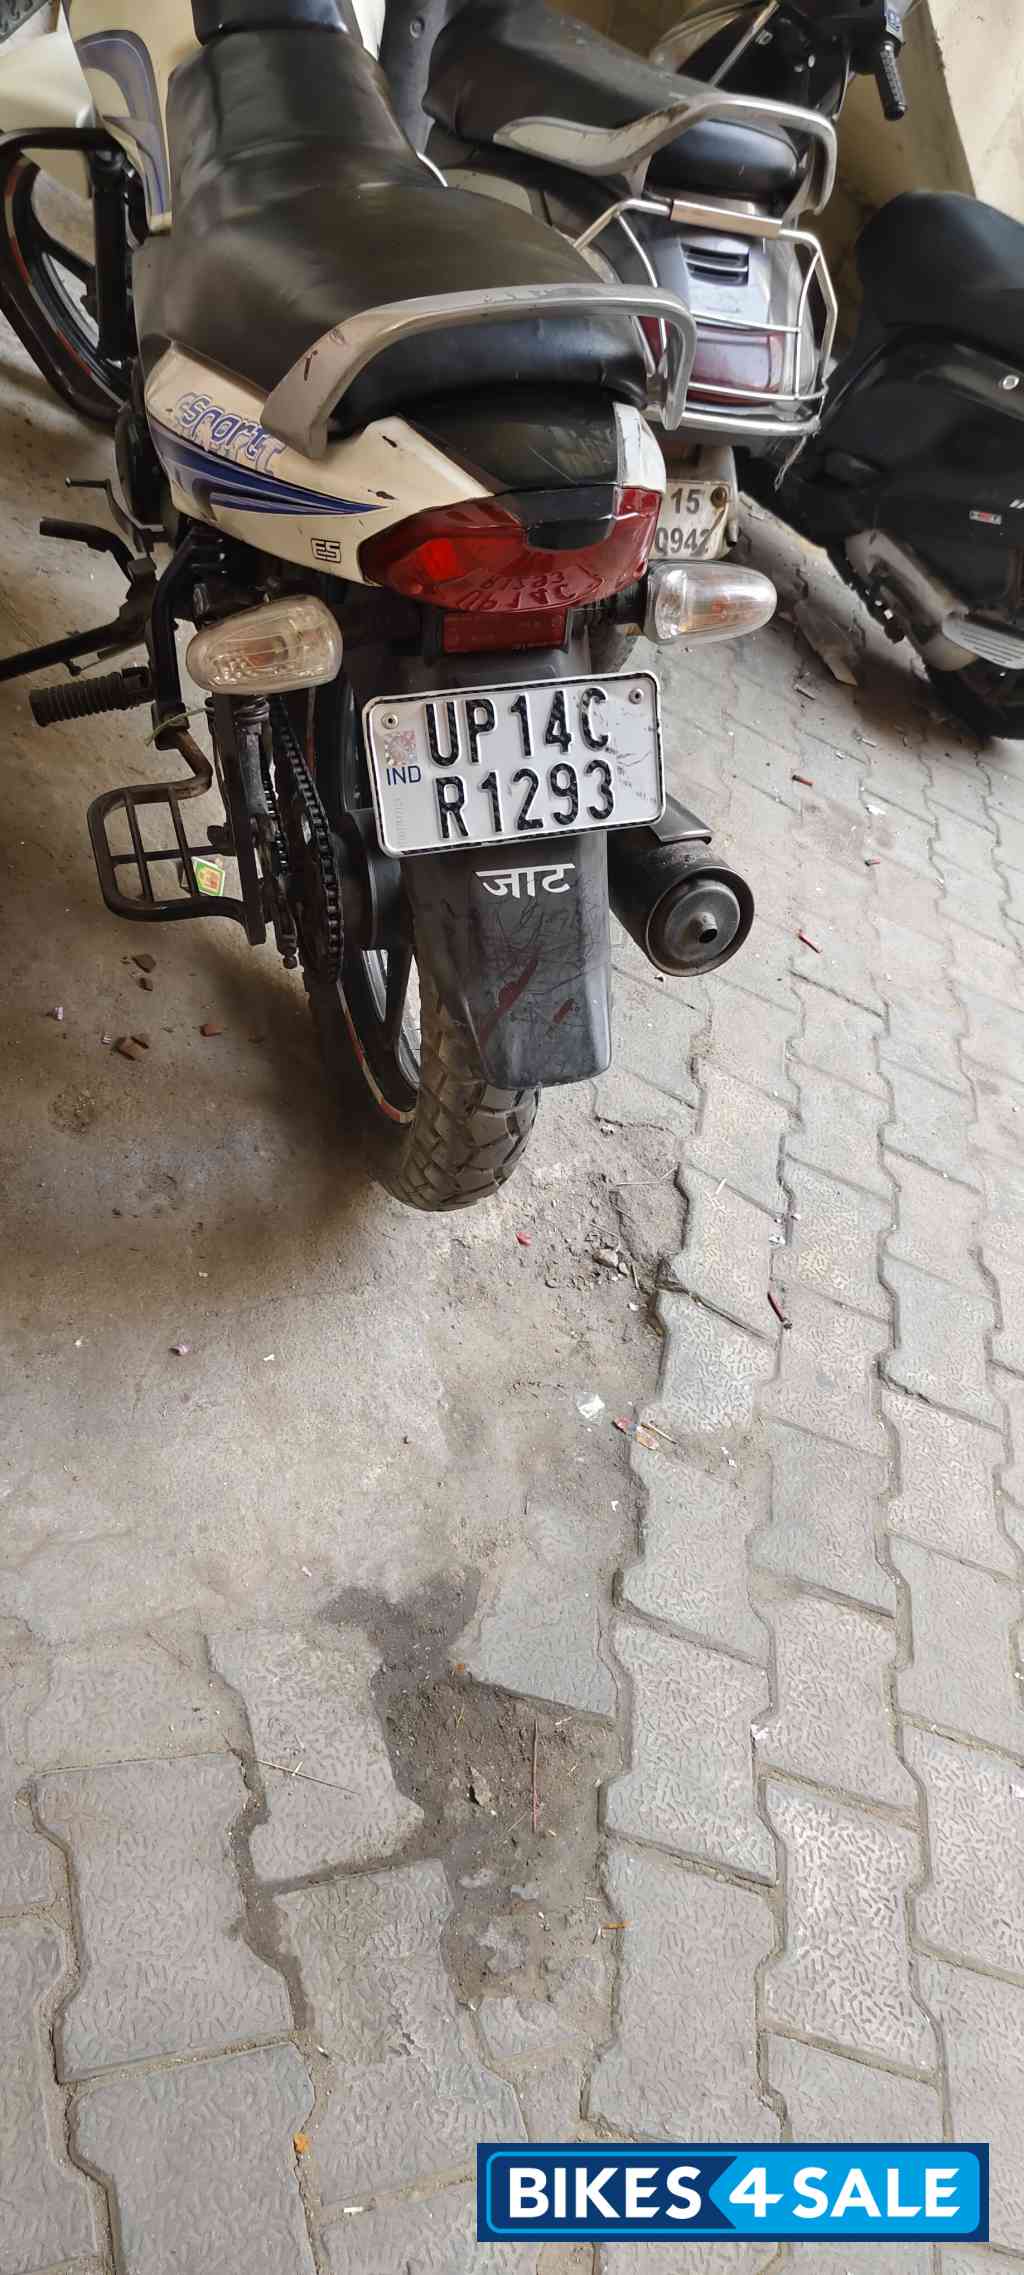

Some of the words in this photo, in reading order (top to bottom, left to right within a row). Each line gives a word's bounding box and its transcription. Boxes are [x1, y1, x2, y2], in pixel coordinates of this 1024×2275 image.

[311, 538, 342, 563] ES
[386, 765, 422, 786] IND
[434, 759, 616, 839] R1293
[475, 863, 576, 898] जाट
